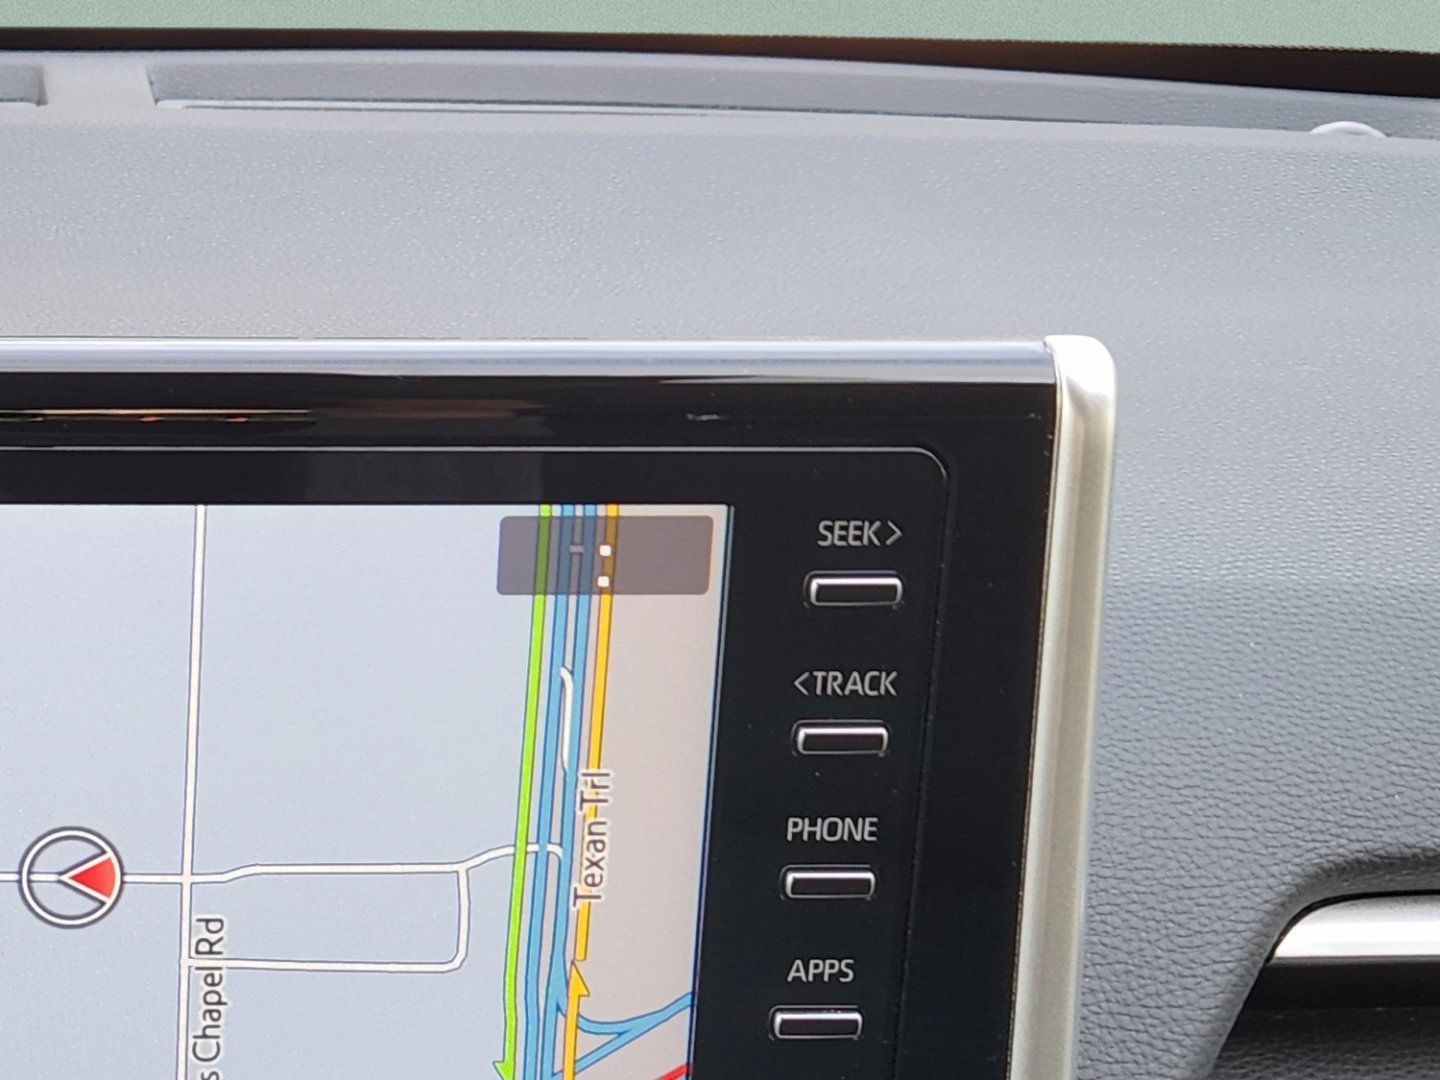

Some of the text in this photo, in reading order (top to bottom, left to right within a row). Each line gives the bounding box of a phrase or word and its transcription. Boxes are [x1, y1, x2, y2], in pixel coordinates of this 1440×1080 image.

[817, 521, 881, 547] SEEK
[812, 672, 898, 696] TRACK
[572, 772, 610, 908] Texan Trl
[786, 817, 878, 842] PHONE
[195, 918, 224, 955] Rd
[787, 959, 855, 983] APPS
[192, 967, 228, 1062] Chapel
